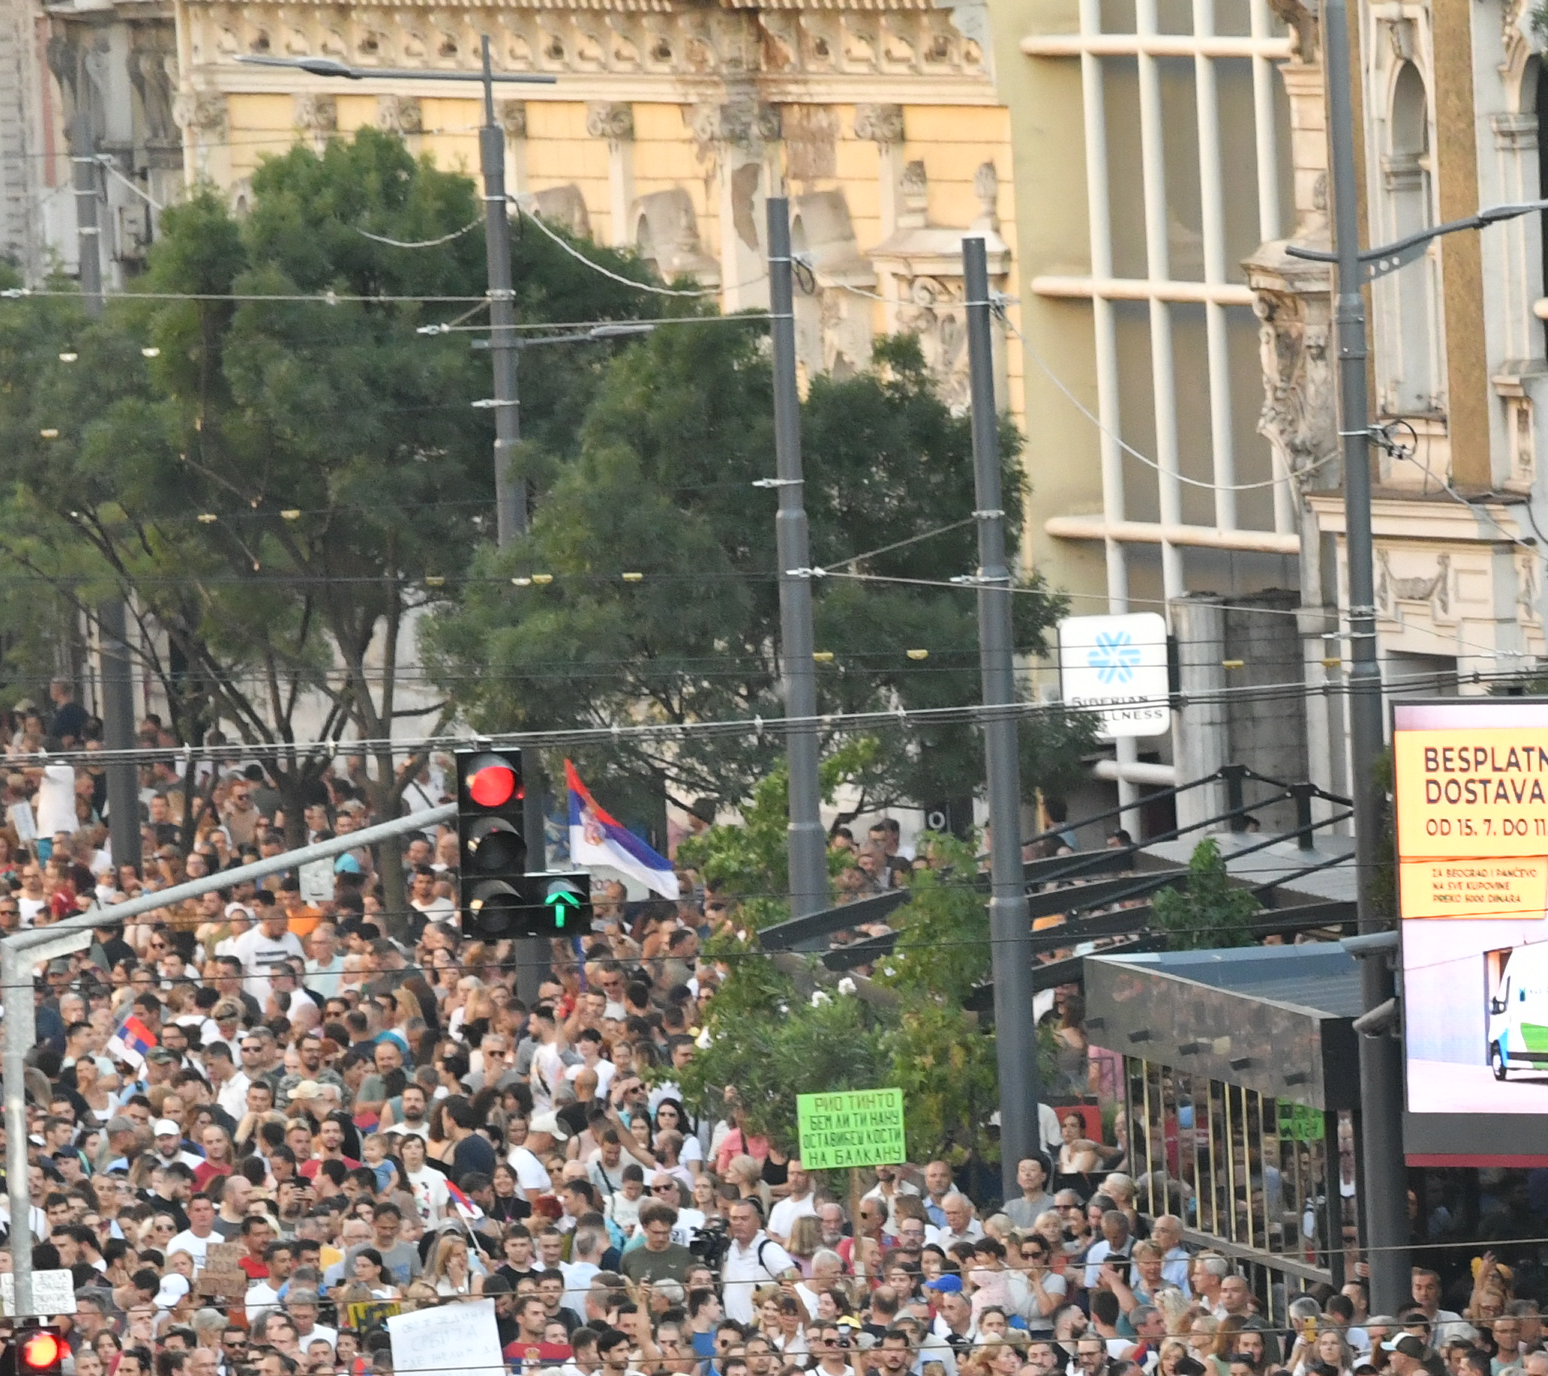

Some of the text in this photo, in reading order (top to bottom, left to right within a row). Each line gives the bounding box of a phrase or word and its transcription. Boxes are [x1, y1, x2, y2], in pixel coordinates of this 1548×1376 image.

[1425, 778, 1546, 804] DOSTAVA
[1426, 818, 1452, 836] OD
[1457, 818, 1478, 836] 15.
[1503, 818, 1529, 837] DO
[1446, 868, 1486, 879] BEOGRAD
[814, 1093, 895, 1113] РИО ТИНТО
